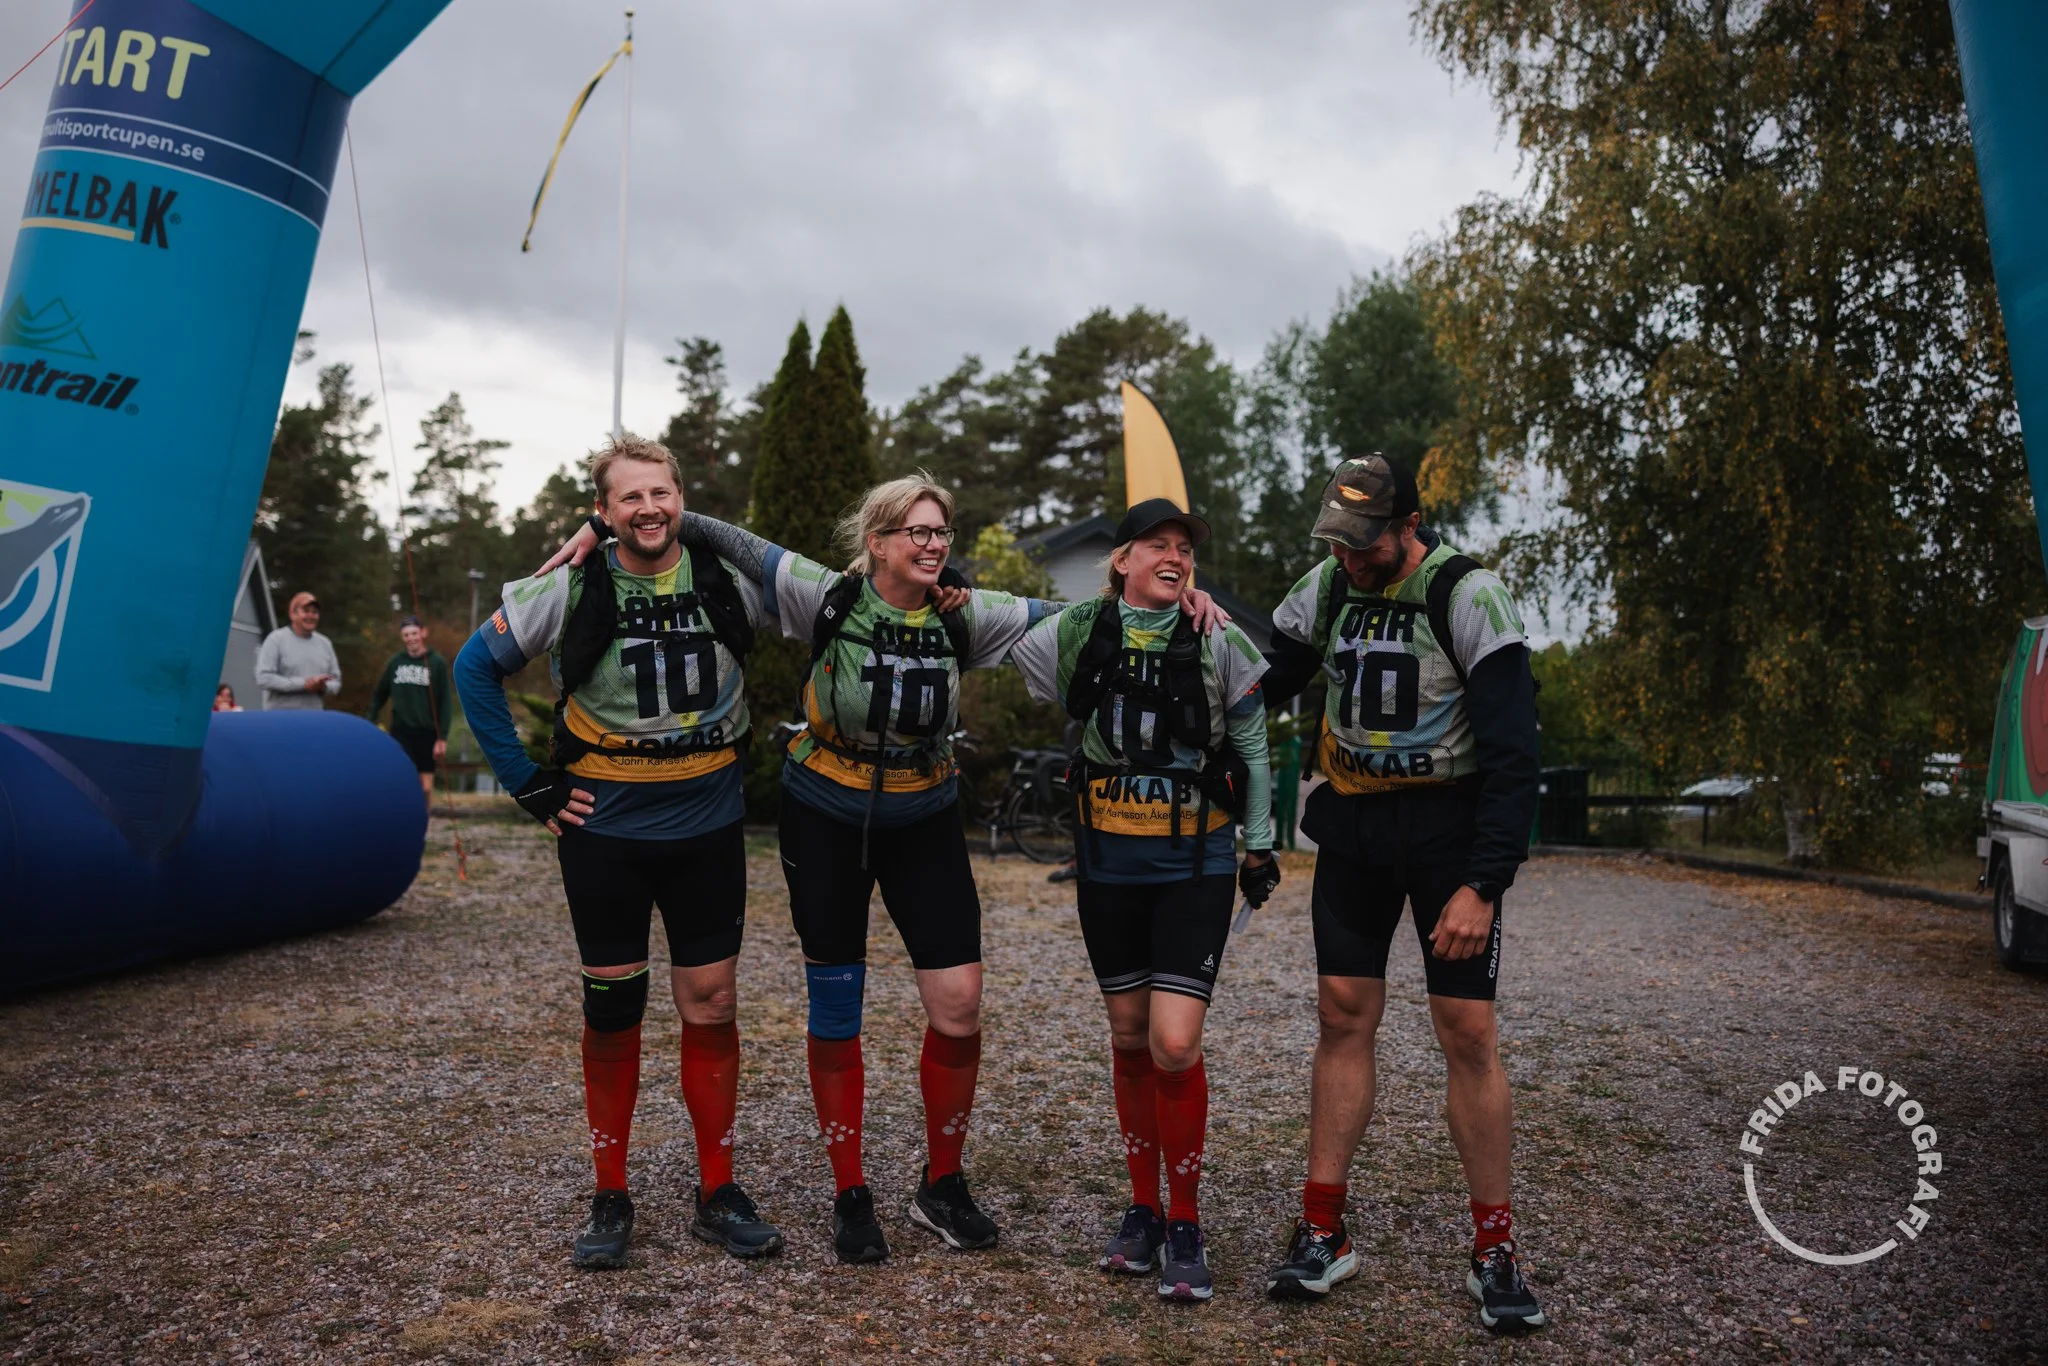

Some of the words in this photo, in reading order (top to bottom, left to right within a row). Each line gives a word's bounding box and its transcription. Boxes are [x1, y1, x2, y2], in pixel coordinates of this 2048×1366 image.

[58, 26, 210, 100] TART
[0, 358, 139, 411] ntrail
[621, 640, 718, 719] 10
[861, 664, 950, 738] 10
[1334, 649, 1420, 732] 10
[1149, 807, 1173, 821] Åker
[1488, 929, 1500, 979] CRAFT
